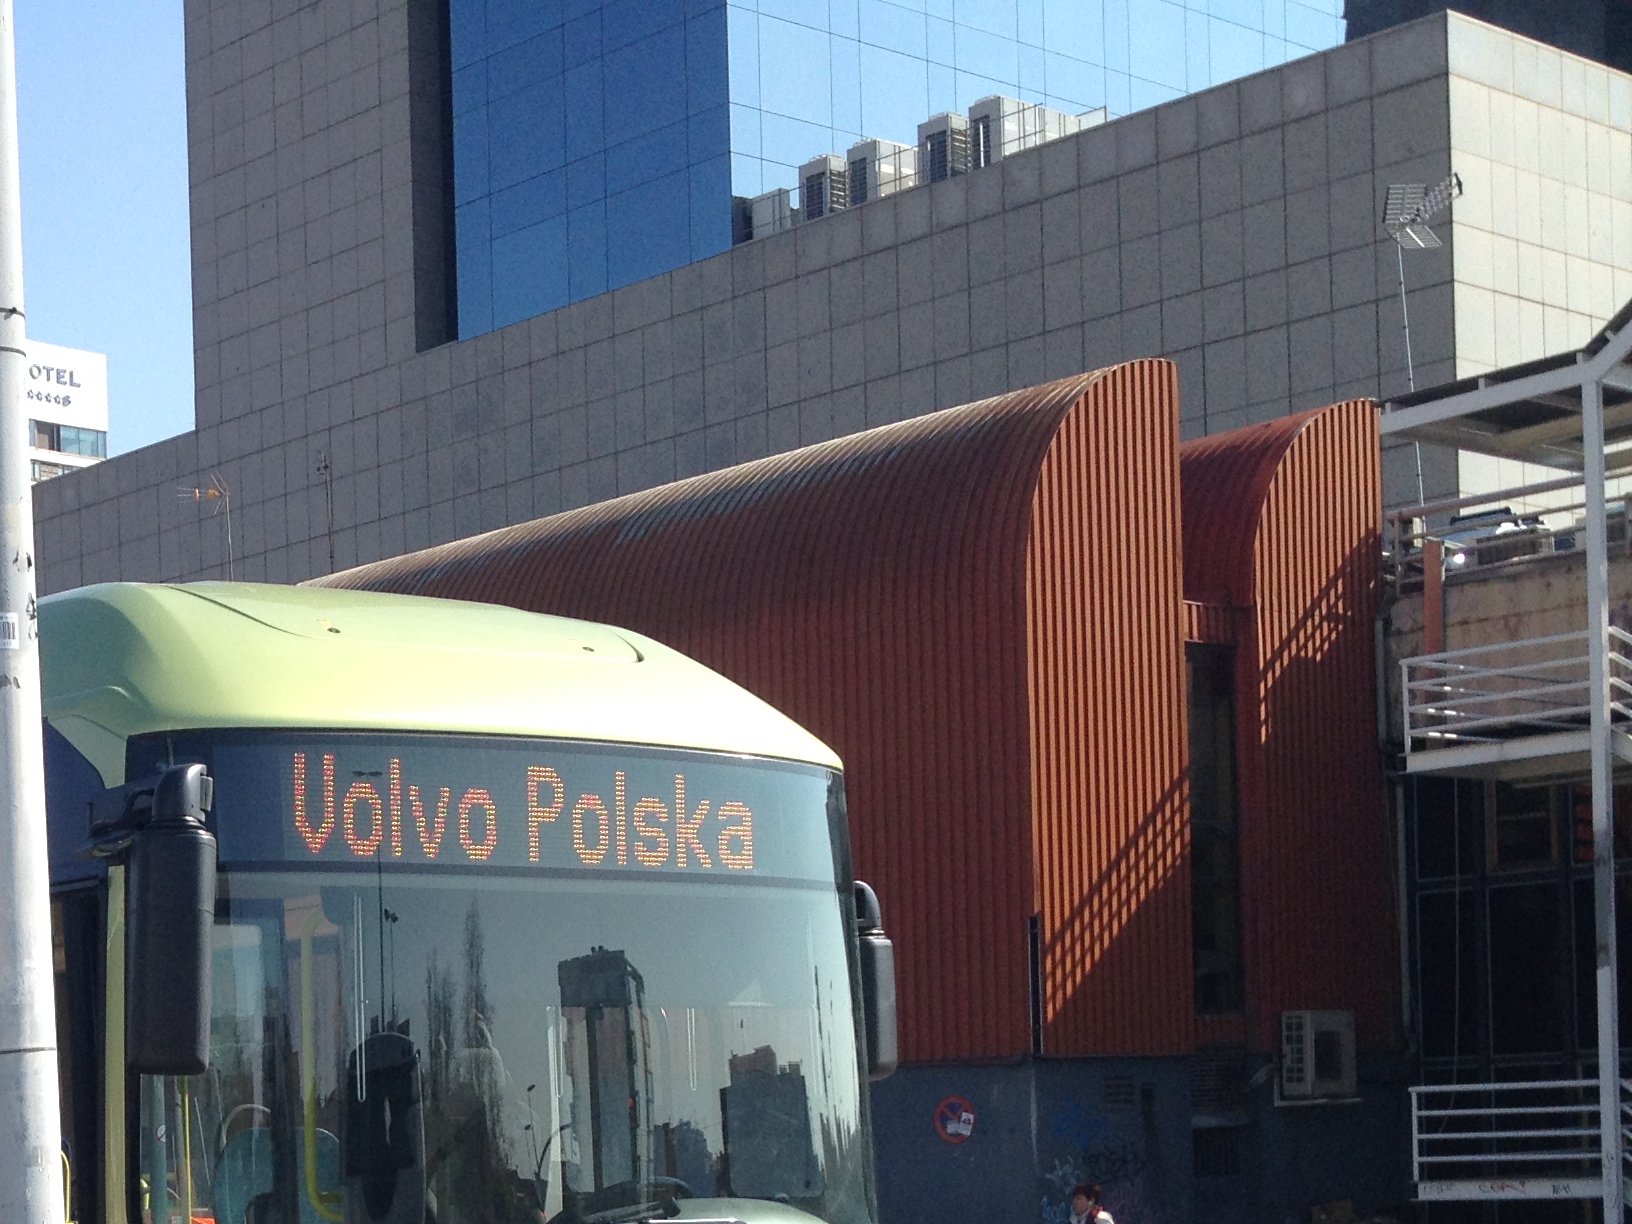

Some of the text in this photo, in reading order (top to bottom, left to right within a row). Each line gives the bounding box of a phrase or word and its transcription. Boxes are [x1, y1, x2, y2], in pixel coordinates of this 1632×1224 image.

[28, 363, 81, 388] OTEL
[292, 752, 754, 870] Volvo Polska
